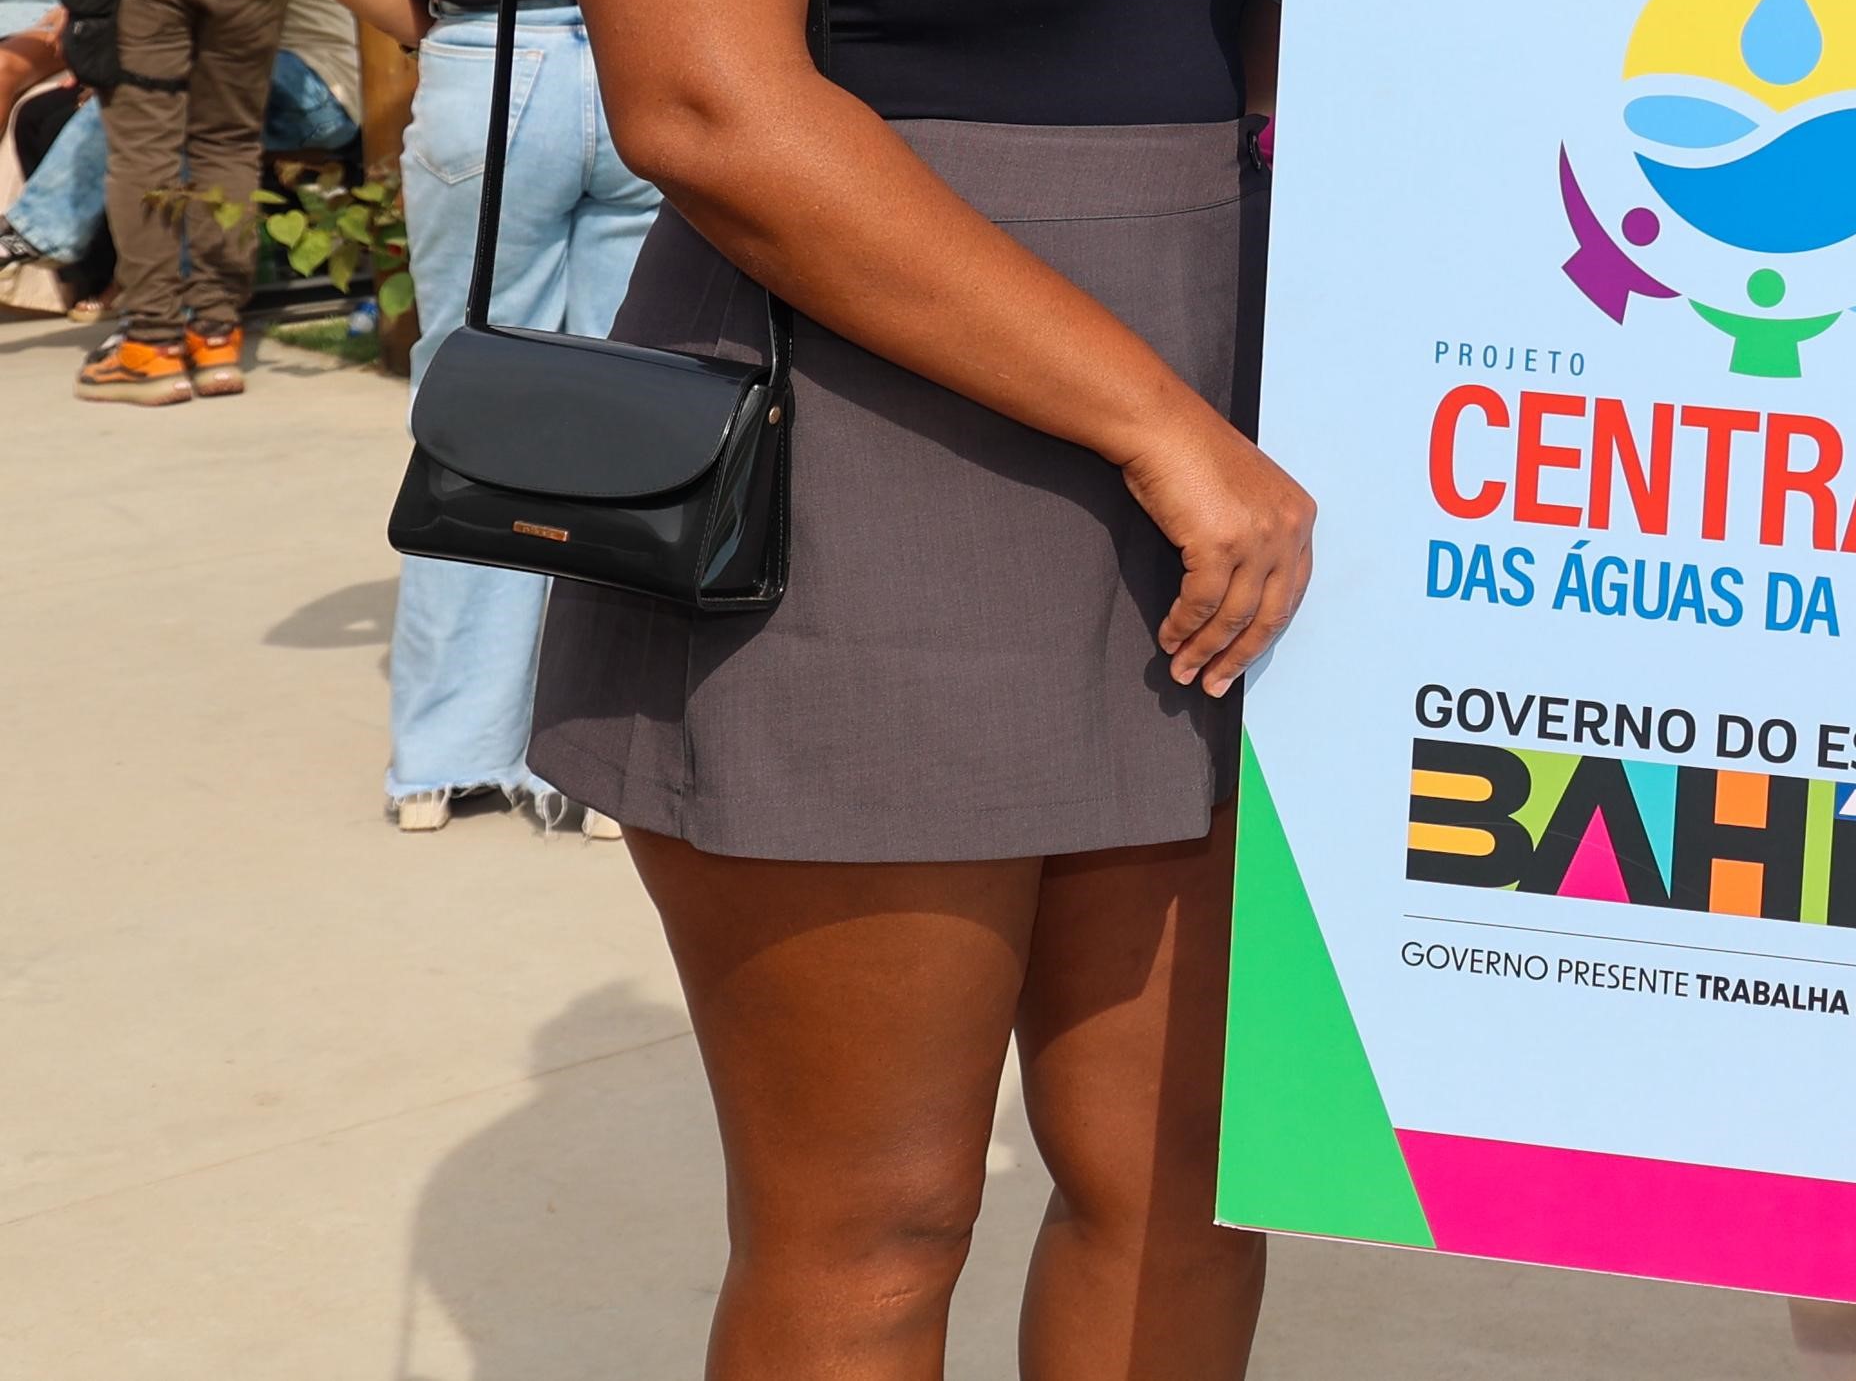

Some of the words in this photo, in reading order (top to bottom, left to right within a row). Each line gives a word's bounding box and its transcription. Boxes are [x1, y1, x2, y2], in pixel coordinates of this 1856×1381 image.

[1434, 340, 1585, 377] PROJETO
[1425, 539, 1535, 607] DAS
[1552, 539, 1744, 628] ÁGUAS
[1764, 571, 1840, 637] DA
[1415, 683, 1696, 754] GOVERNO
[1715, 713, 1798, 764] DO
[1401, 941, 1549, 981] GOVERNO
[1557, 958, 1689, 997] PRESENTE
[1696, 973, 1849, 1015] TRABALHA
